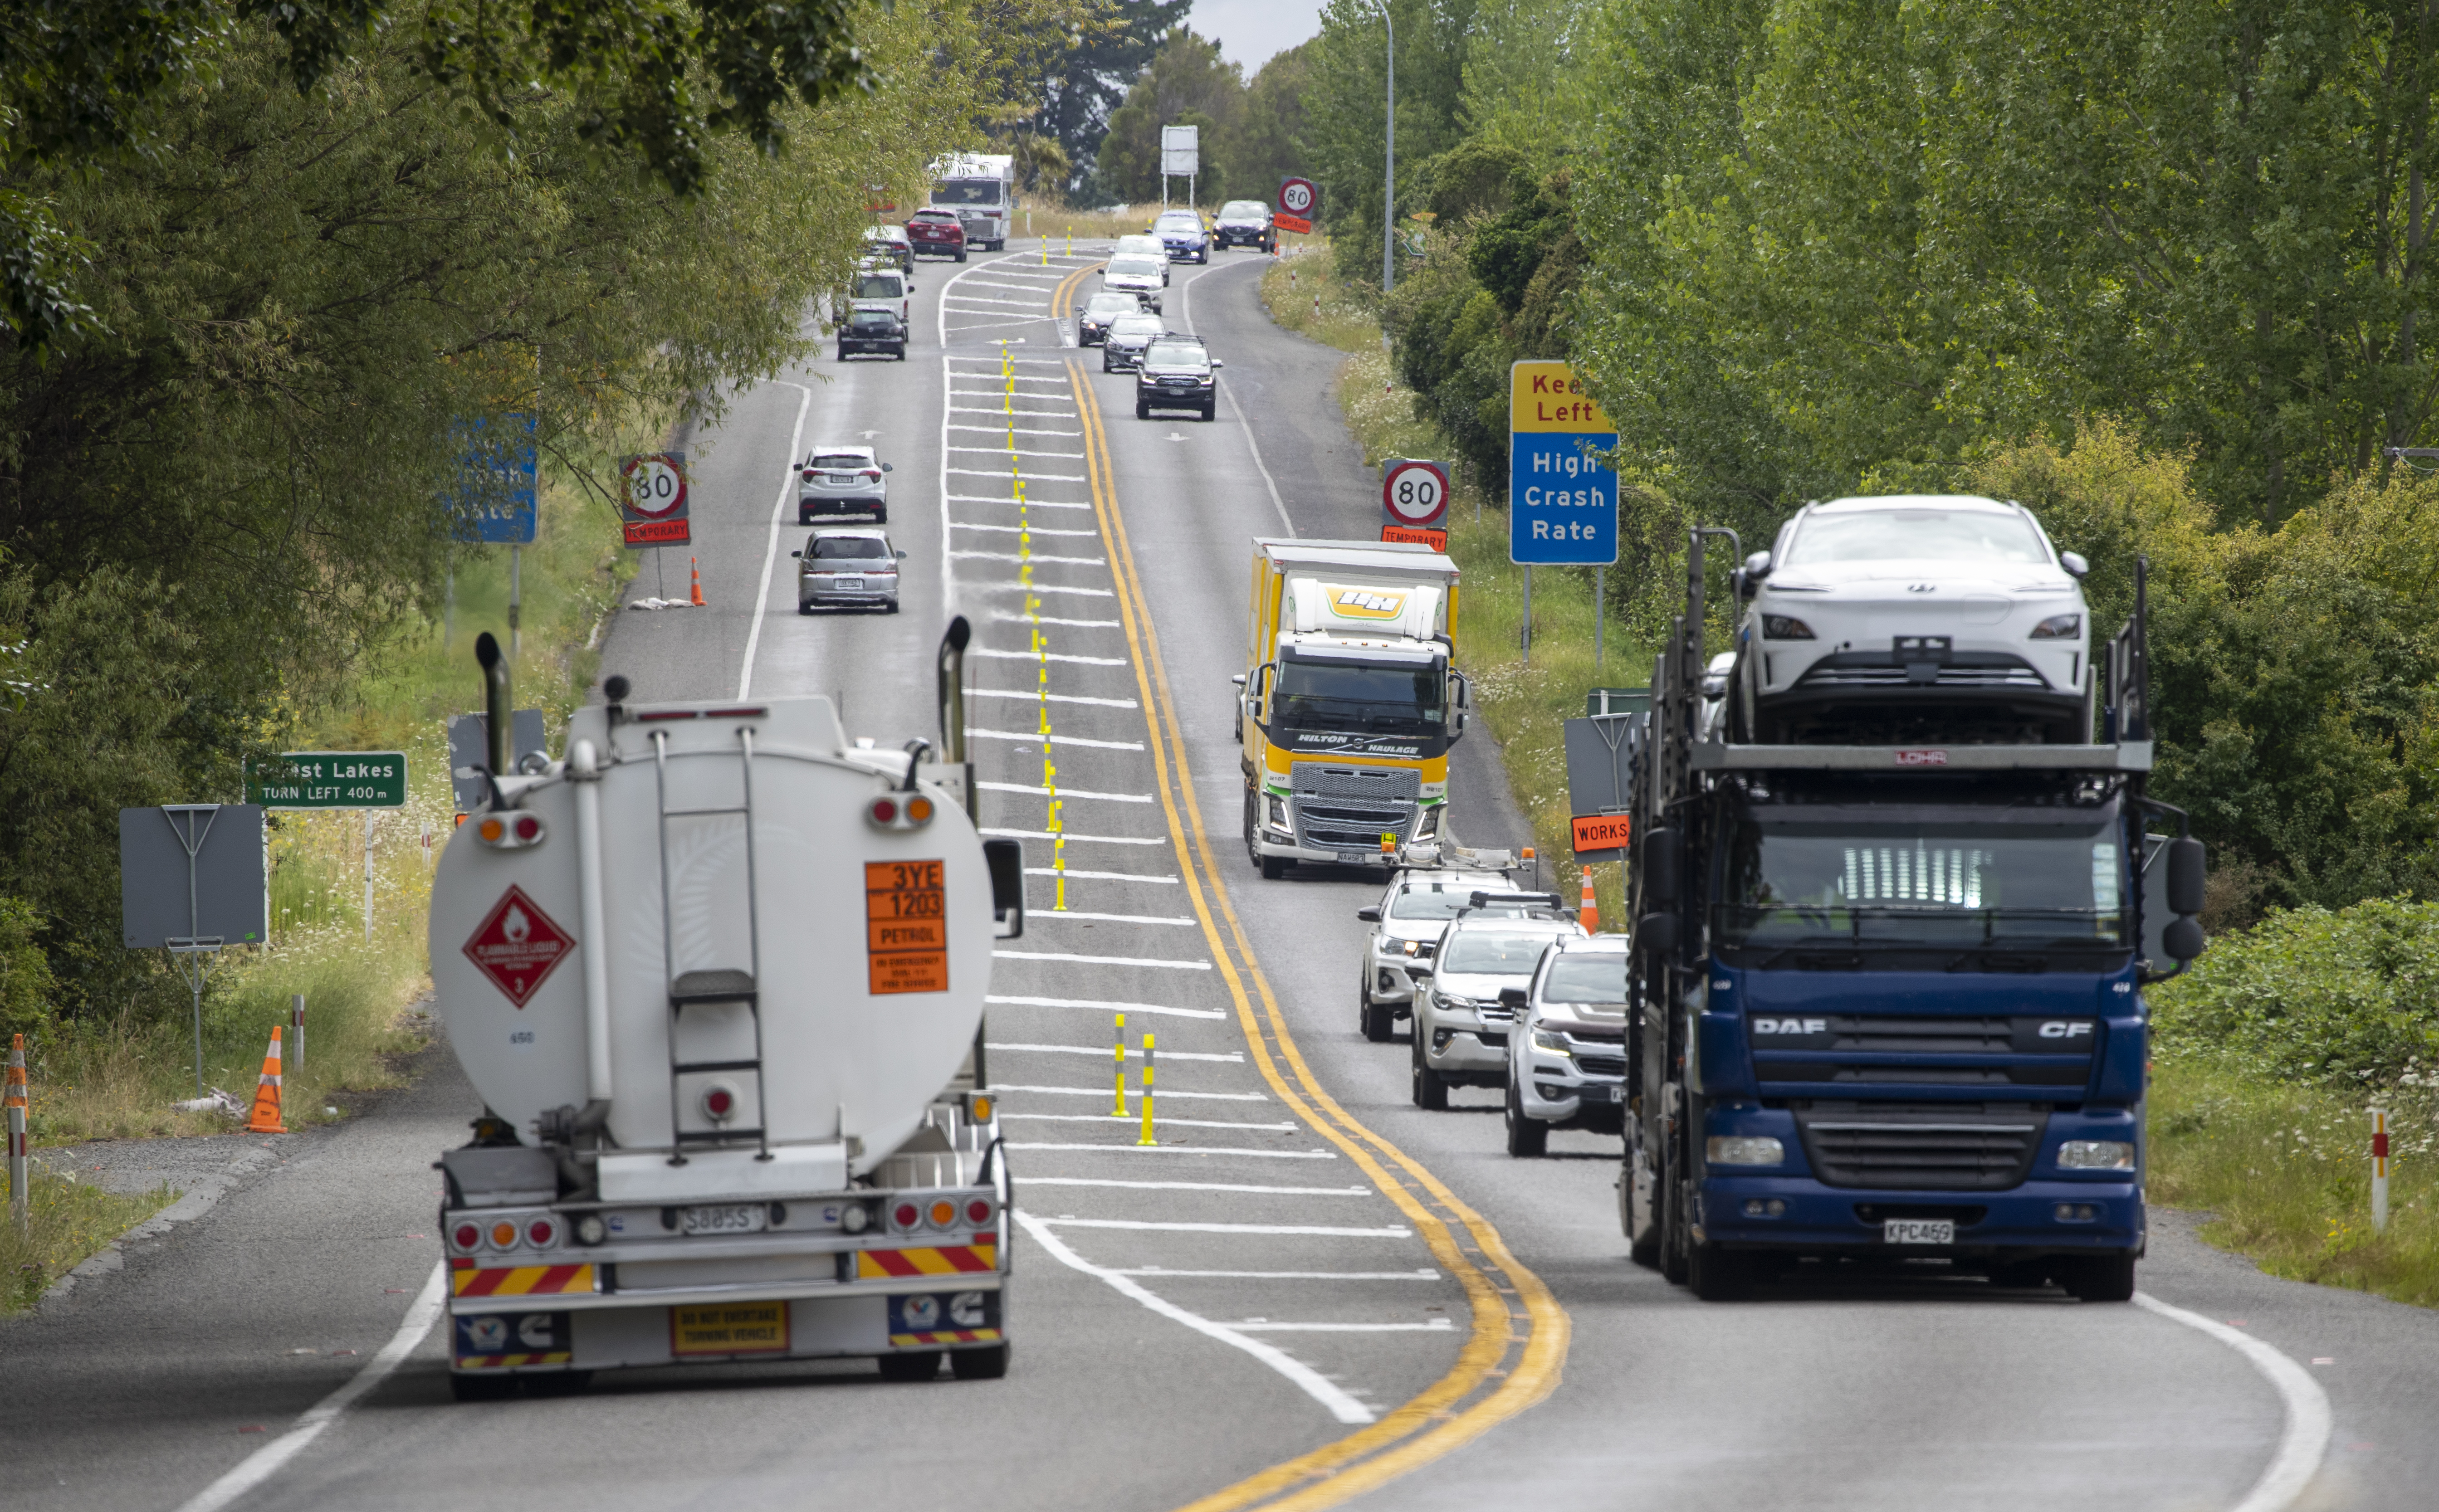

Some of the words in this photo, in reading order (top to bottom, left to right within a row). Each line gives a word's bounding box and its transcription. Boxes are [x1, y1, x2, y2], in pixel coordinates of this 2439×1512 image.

[1287, 190, 1307, 205] 80
[1533, 375, 1583, 395] Kee
[1537, 401, 1593, 422] Left
[1533, 452, 1597, 479] High
[637, 474, 671, 499] 80
[1399, 481, 1434, 505] 80
[1525, 486, 1604, 507] Crash
[627, 525, 685, 538] TEMPORARY
[1532, 519, 1596, 541] Rate
[1386, 532, 1443, 547] TEMPORARY
[1298, 734, 1349, 744] HILTON
[1367, 744, 1419, 754] HAULAGE
[256, 762, 323, 779] Fest
[333, 763, 393, 778] Lakes
[263, 786, 299, 799] TURN
[308, 786, 341, 800] LEFT
[347, 786, 374, 799] 400
[1578, 824, 1627, 842] WORKS
[894, 864, 939, 890] 3YE
[890, 893, 940, 916] 1203
[881, 927, 935, 944] PETROL
[514, 977, 524, 993] 3
[1754, 1019, 1826, 1034] DAF
[2038, 1022, 2093, 1038] CF
